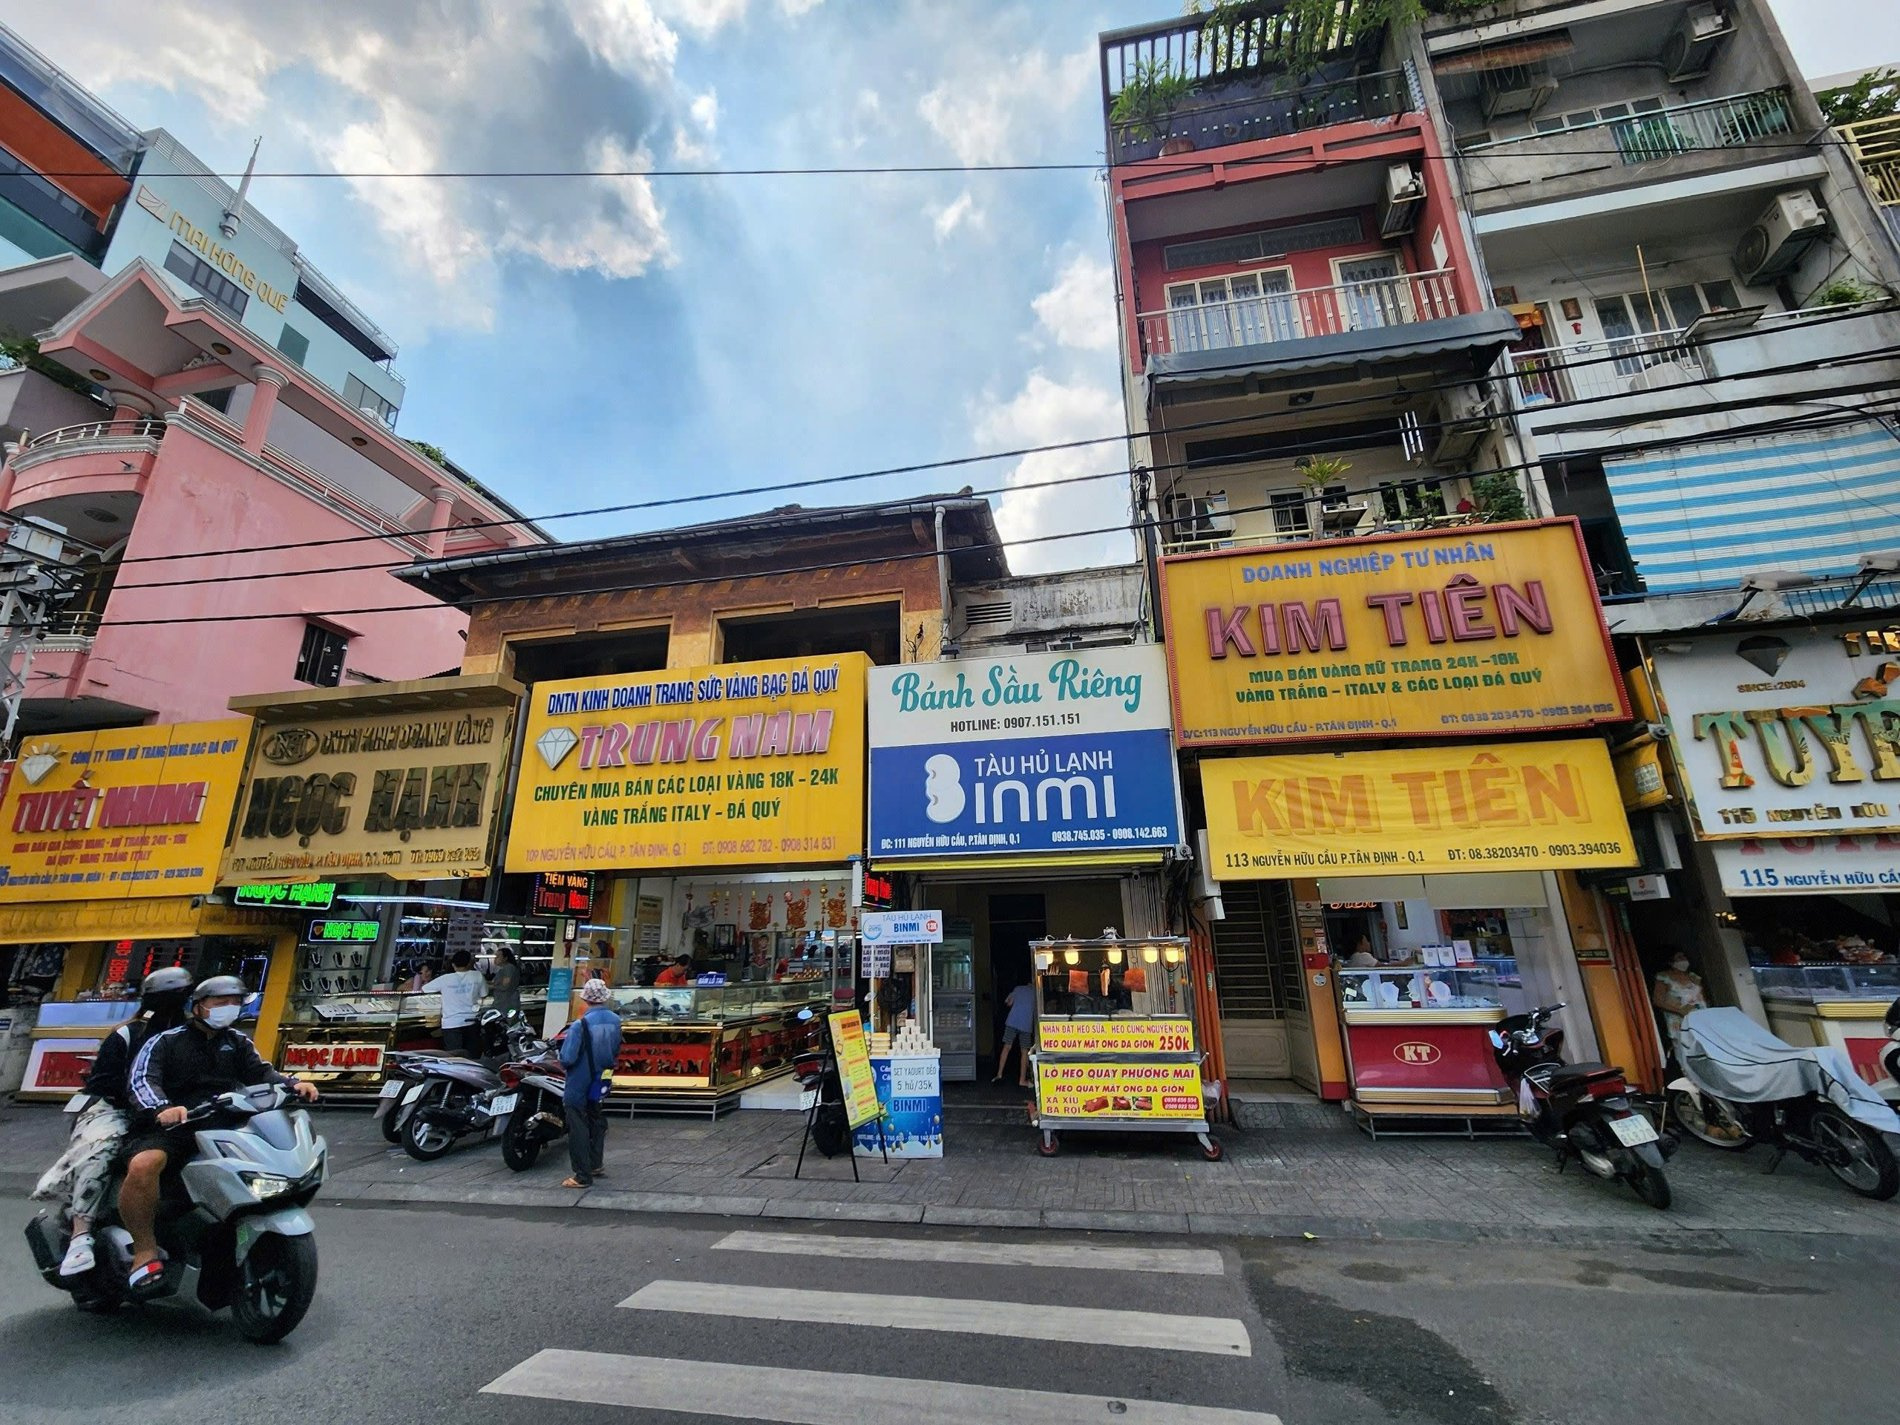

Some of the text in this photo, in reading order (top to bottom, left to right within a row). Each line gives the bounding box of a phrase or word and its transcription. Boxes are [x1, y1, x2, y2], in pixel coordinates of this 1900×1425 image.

[1243, 542, 1496, 584] DOANH NGHIỆP TƯ NHÂN
[1205, 572, 1555, 659] KIM TIÊN
[1249, 668, 1284, 684] MUA
[1287, 664, 1318, 682] BÁN
[1321, 662, 1361, 680] VÀNG
[1365, 659, 1388, 676] NỮ
[1391, 657, 1444, 675] TRANG
[547, 663, 841, 715] DNTN KINH DOANH TRANG SỨC VÀNG BẠC ĐÁ QUÝ
[891, 659, 1143, 714] Bánh Sầu Riêng
[1236, 667, 1544, 704] VÀNG TRẮNG ITALY & CÁC LOẠI ĐÁ QUÝ
[950, 713, 1081, 733] HOTLINE: 0907.151.151
[577, 709, 835, 769] TRUNG NAM
[974, 748, 1113, 777] TÀU HỦ LẠNH
[534, 767, 840, 802] CHUYÊN MUA BÁN CÁC LOẠI VÀNG 18K 24K
[1232, 774, 1383, 837] KIM
[1392, 752, 1593, 830] TIÊN
[241, 771, 357, 848] NGỌC
[583, 798, 781, 827] VÀNG TRẮNG ITALY ĐÁ QUÝ
[1718, 807, 1757, 824] 115
[894, 837, 906, 849] 111
[907, 832, 935, 849] NGUYỄN
[1009, 833, 1021, 846] Q.1
[1225, 852, 1249, 869] 113
[1252, 848, 1293, 867] NGUYỄN
[1294, 849, 1316, 866] HỮU
[1341, 848, 1373, 865] P.TÂN
[1374, 850, 1399, 866] ĐỊNH
[1409, 850, 1425, 864] Q.1
[1448, 848, 1466, 862] ĐT:
[1468, 845, 1539, 860] 08.38203470
[1548, 842, 1622, 857] 0903.394036
[1740, 868, 1874, 887] 115 NGUYỄN HỮU
[894, 922, 920, 932] BINMI
[1044, 1039, 1058, 1048] HEO
[1061, 1039, 1081, 1048] QUAY
[1102, 1040, 1118, 1048] ONG
[1121, 1039, 1132, 1048] DA
[1159, 1036, 1189, 1050] 250k
[1402, 1045, 1432, 1062] KT
[897, 1081, 901, 1090] 5
[1062, 1069, 1083, 1078] HEO
[1088, 1068, 1118, 1080] QUAY
[1173, 1069, 1195, 1079] MAI
[1076, 1085, 1099, 1093] QUAY
[1123, 1085, 1143, 1093] ONG
[893, 1099, 927, 1112] BINMI
